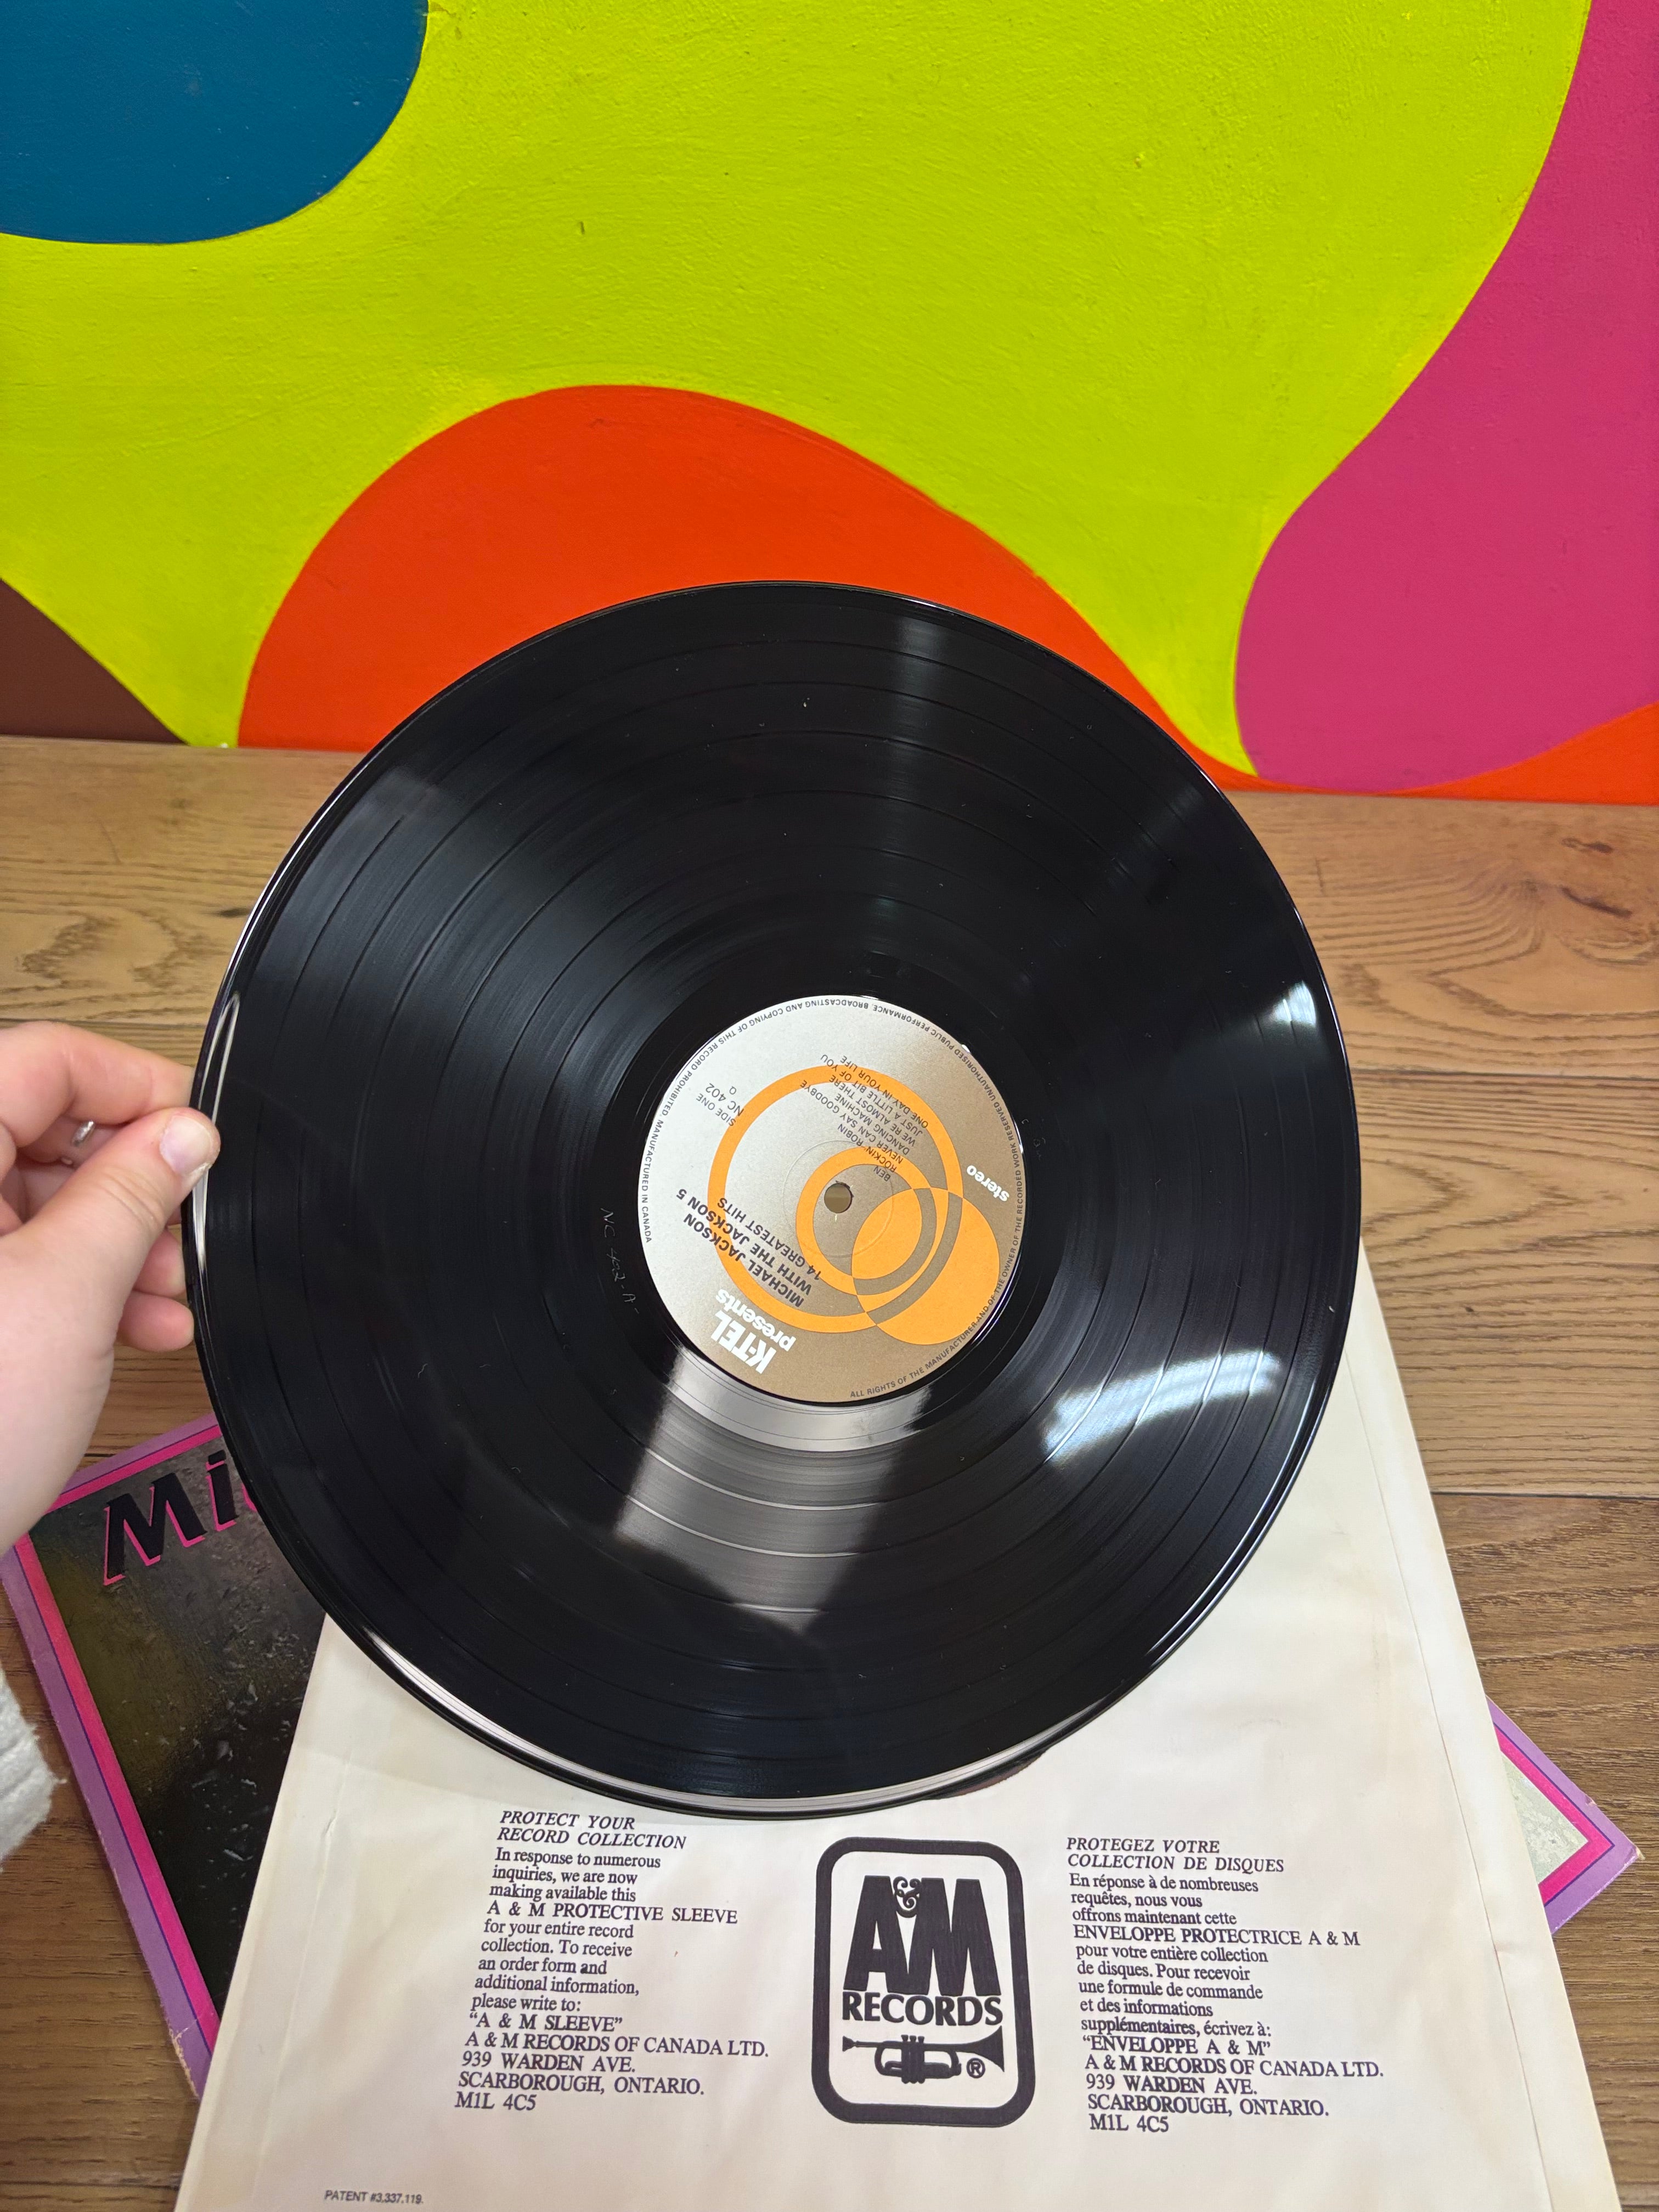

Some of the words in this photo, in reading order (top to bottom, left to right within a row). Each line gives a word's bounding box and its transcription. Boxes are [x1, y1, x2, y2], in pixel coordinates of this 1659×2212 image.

[840, 1055, 858, 1072] LIFE
[729, 1086, 737, 1095] Q
[858, 1070, 881, 1092] YOUR
[696, 1093, 715, 1110] ONE
[705, 1082, 726, 1102] 402
[800, 1080, 840, 1114] GOODBYE
[882, 1090, 893, 1101] IN
[715, 1108, 736, 1126] SIDE
[727, 1101, 744, 1117] NC
[834, 1093, 873, 1126] MACHINE
[892, 1099, 911, 1115] DAY
[839, 1113, 858, 1128] SAY
[910, 1112, 928, 1128] ONE
[837, 1123, 864, 1147] ROBIN
[857, 1126, 877, 1143] CAN
[873, 1124, 910, 1155] DANCING
[641, 1119, 664, 1192] MANUFACTURED
[876, 1140, 904, 1164] NEVER
[873, 1165, 891, 1182] BEN
[967, 1165, 1009, 1201] stereo
[641, 1194, 648, 1203] IN
[676, 1188, 687, 1200] 5
[717, 1197, 747, 1223] HITS
[641, 1206, 652, 1243] CANADA
[687, 1196, 750, 1245] JACKSON
[683, 1213, 746, 1262] JACKSON
[744, 1220, 805, 1268] GREATEST
[749, 1243, 776, 1268] THE
[776, 1263, 812, 1296] WITH
[806, 1265, 821, 1280] 14
[748, 1259, 804, 1308] MICHAEL
[714, 1285, 796, 1351] presents
[710, 1310, 776, 1374] K-TEL
[500, 1810, 580, 1827] PROTECT
[588, 1815, 635, 1830] YOUR
[496, 1827, 569, 1843] RECORD
[578, 1832, 686, 1849] COLLECTION
[1066, 1837, 1154, 1852] PROTEGEZ
[1163, 1840, 1220, 1853] VOTRE
[495, 1847, 511, 1861] In
[513, 1852, 573, 1870] response
[577, 1853, 591, 1865] to
[593, 1856, 661, 1868] numerous
[1068, 1854, 1175, 1870] COLLECTION
[1183, 1857, 1207, 1870] DE
[1215, 1857, 1284, 1875] DISQUES
[492, 1864, 556, 1884] inquiries,
[561, 1872, 580, 1882] we
[583, 1872, 605, 1883] are
[607, 1874, 637, 1884] now
[1069, 1873, 1090, 1887] En
[1092, 1874, 1145, 1892] réponse
[1149, 1875, 1158, 1889] à
[1160, 1876, 1176, 1889] de
[1179, 1877, 1259, 1892] nombreuses
[489, 1883, 543, 1903] making
[545, 1886, 607, 1900] available
[612, 1887, 636, 1902] this
[1071, 1891, 1132, 1908] requêtes,
[1135, 1896, 1167, 1906] nous
[1170, 1897, 1203, 1908] vous
[487, 1900, 500, 1915] A
[509, 1901, 521, 1916] &
[528, 1903, 546, 1917] M
[552, 1903, 663, 1921] PROTECTIVE
[672, 1908, 737, 1924] SLEEVE
[1072, 1908, 1121, 1922] offrons
[1124, 1910, 1201, 1925] maintenant
[1205, 1912, 1237, 1925] cette
[483, 1918, 506, 1933] for
[508, 1923, 542, 1937] your
[544, 1921, 585, 1936] entire
[588, 1925, 634, 1938] record
[1073, 1924, 1176, 1942] ENVELOPPE
[1180, 1928, 1302, 1945] PROTECTRICE
[1308, 1931, 1322, 1945] A
[1327, 1931, 1338, 1945] &
[1341, 1932, 1361, 1945] M
[481, 1938, 553, 1953] collection.
[558, 1939, 579, 1954] To
[582, 1942, 632, 1957] receive
[1075, 1945, 1108, 1960] pour
[1111, 1945, 1147, 1959] votre
[1150, 1945, 1198, 1961] entière
[1200, 1947, 1268, 1962] collection
[478, 1960, 495, 1970] an
[500, 1956, 539, 1971] order
[541, 1957, 577, 1973] form
[580, 1960, 607, 1974] and
[1077, 1960, 1094, 1974] de
[1098, 1961, 1153, 1980] disques.
[1155, 1963, 1190, 1979] Pour
[1193, 1966, 1250, 1980] recevoir
[475, 1974, 548, 1991] additional
[550, 1976, 639, 1996] information,
[1079, 1982, 1105, 1993] une
[1107, 1979, 1163, 1996] formule
[1166, 1982, 1183, 1997] de
[1186, 1984, 1263, 1999] commande
[470, 1993, 517, 2011] please
[520, 1995, 557, 2011] write
[561, 1998, 580, 2012] to:
[842, 1991, 1003, 2026] RECORDS
[1080, 1999, 1094, 2012] et
[1097, 1997, 1121, 2013] des
[1123, 1998, 1214, 2017] informations
[470, 2012, 490, 2028] “A
[499, 2013, 512, 2028] &
[518, 2013, 538, 2030] M
[544, 2015, 623, 2032] SLEEVE”
[1081, 2016, 1200, 2037] supplémentaires,
[1204, 2020, 1254, 2036] écrivez
[1257, 2021, 1271, 2036] à:
[465, 2031, 479, 2046] A
[484, 2032, 498, 2047] &
[500, 2033, 520, 2049] M
[522, 2033, 610, 2052] RECORDS
[614, 2036, 640, 2052] OF
[644, 2037, 723, 2055] CANADA
[727, 2040, 768, 2057] LTD.
[1082, 2034, 1198, 2055] “ENVELOPPE
[1206, 2039, 1221, 2054] A
[1227, 2039, 1240, 2055] &
[1246, 2040, 1271, 2056] M”
[462, 2051, 492, 2067] 939
[501, 2052, 584, 2071] WARDEN
[591, 2056, 635, 2073] AVE.
[1085, 2054, 1099, 2069] A
[1103, 2054, 1116, 2070] &
[1119, 2055, 1137, 2071] M
[1140, 2056, 1227, 2074] RECORDS
[1230, 2058, 1255, 2075] OF
[1260, 2060, 1339, 2076] CANADA
[1341, 2062, 1383, 2077] LTD.
[458, 2071, 605, 2095] SCARBOROUGH,
[614, 2076, 704, 2095] ONTARIO.
[1086, 2073, 1115, 2090] 939
[1122, 2075, 1205, 2094] WARDEN
[1214, 2078, 1257, 2095] AVE.
[454, 2091, 495, 2109] M1L
[503, 2094, 537, 2111] 4C5
[1088, 2094, 1232, 2117] SCARBOROUGH,
[1239, 2098, 1329, 2116] ONTARIO.
[1088, 2113, 1129, 2131] M1L
[1137, 2115, 1169, 2132] 4C5
[324, 2190, 368, 2202] PATENT
